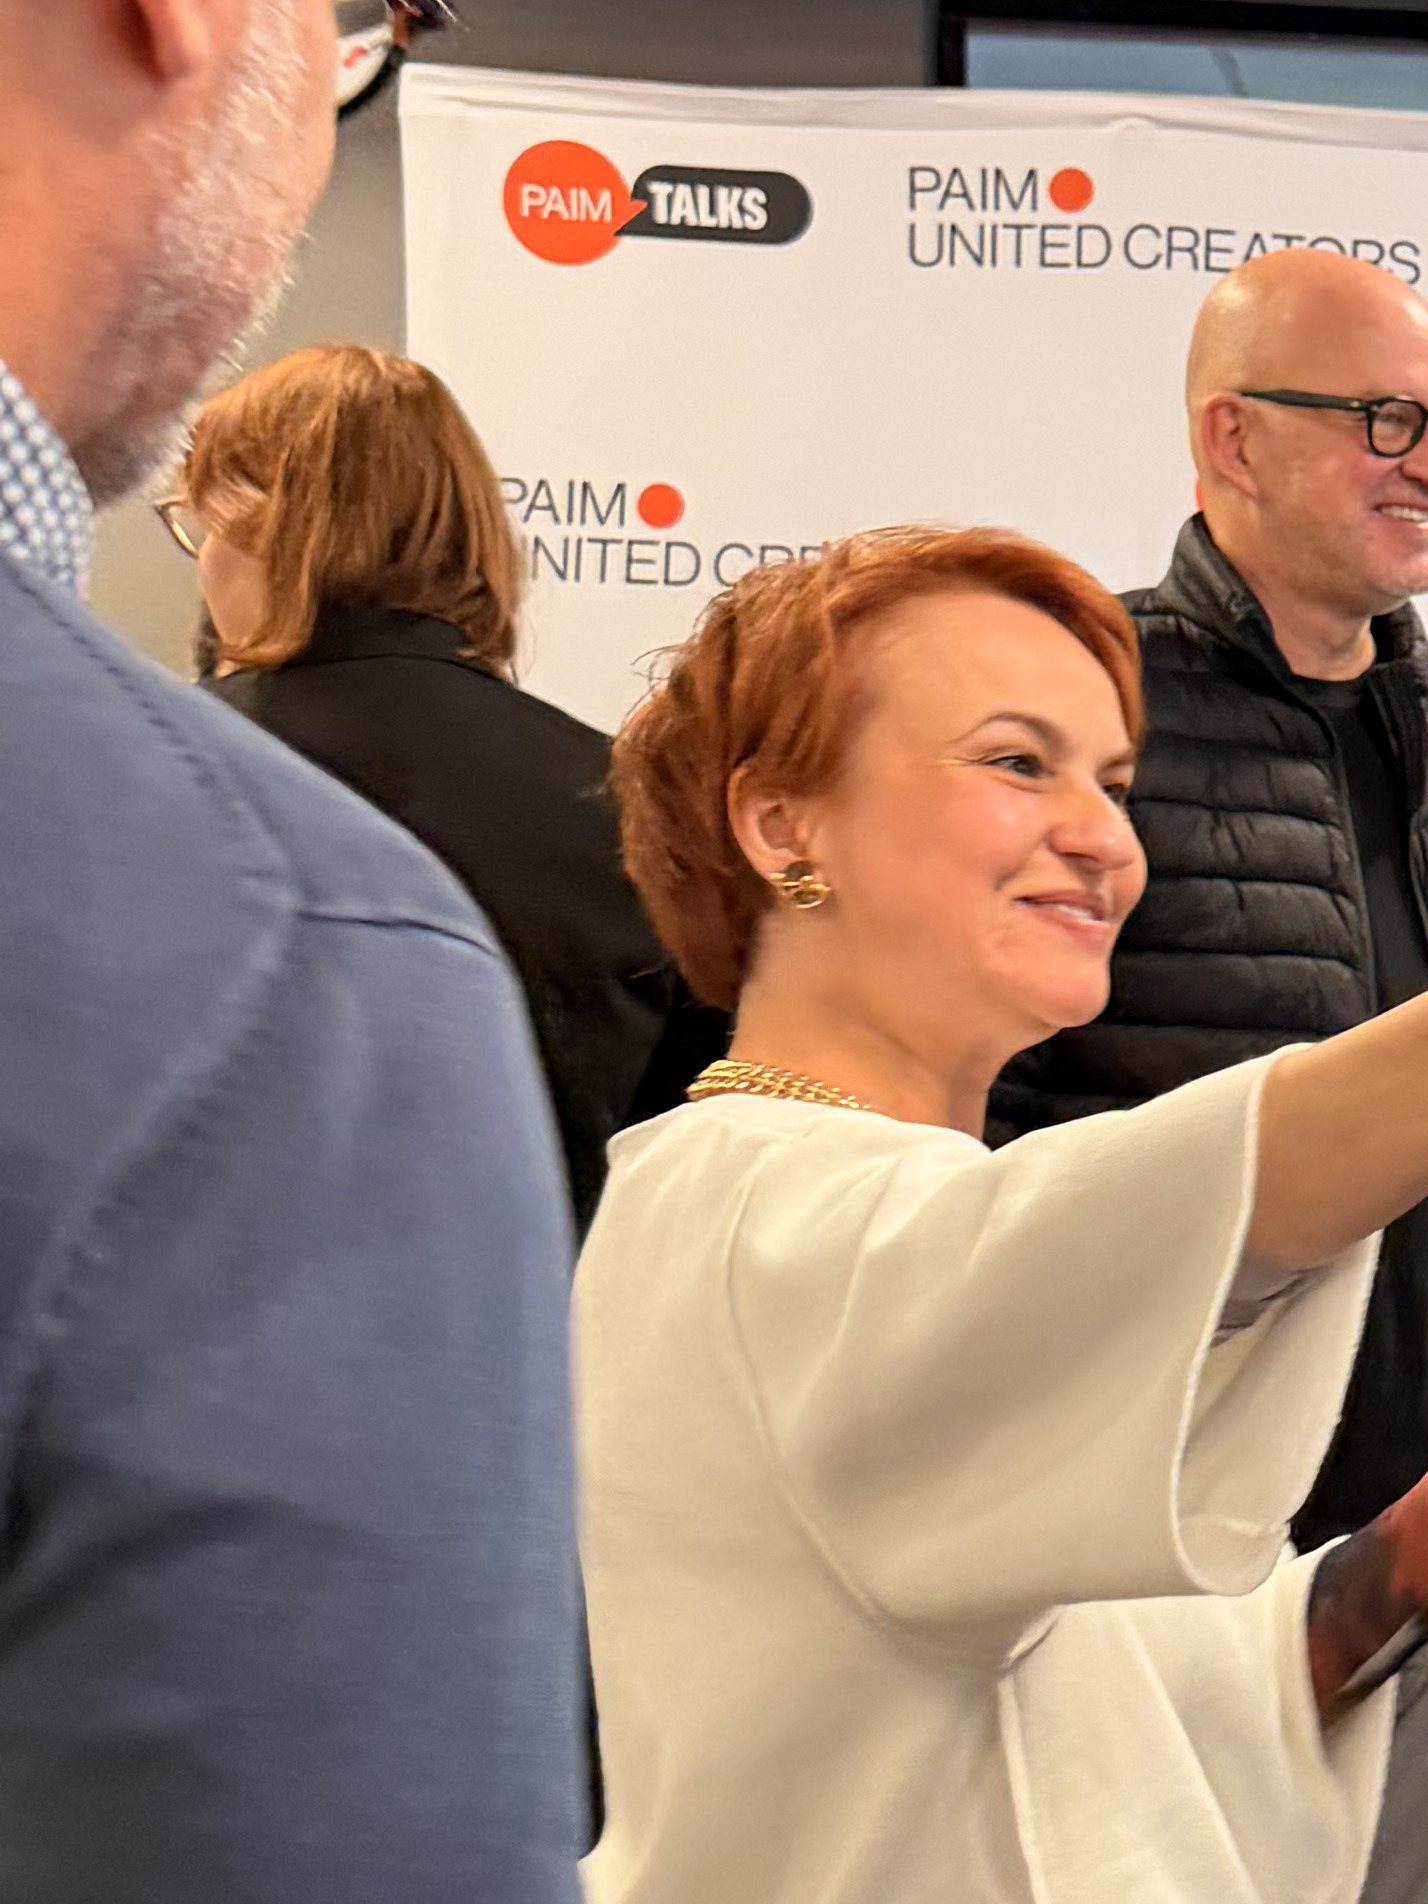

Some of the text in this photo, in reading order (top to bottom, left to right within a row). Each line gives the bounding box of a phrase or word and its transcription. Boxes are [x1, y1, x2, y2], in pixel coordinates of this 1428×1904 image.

[519, 181, 769, 231] PAIM TALKS
[908, 166, 1039, 213] PAIM
[907, 222, 1113, 269] UNITED
[523, 535, 702, 586] NITED
